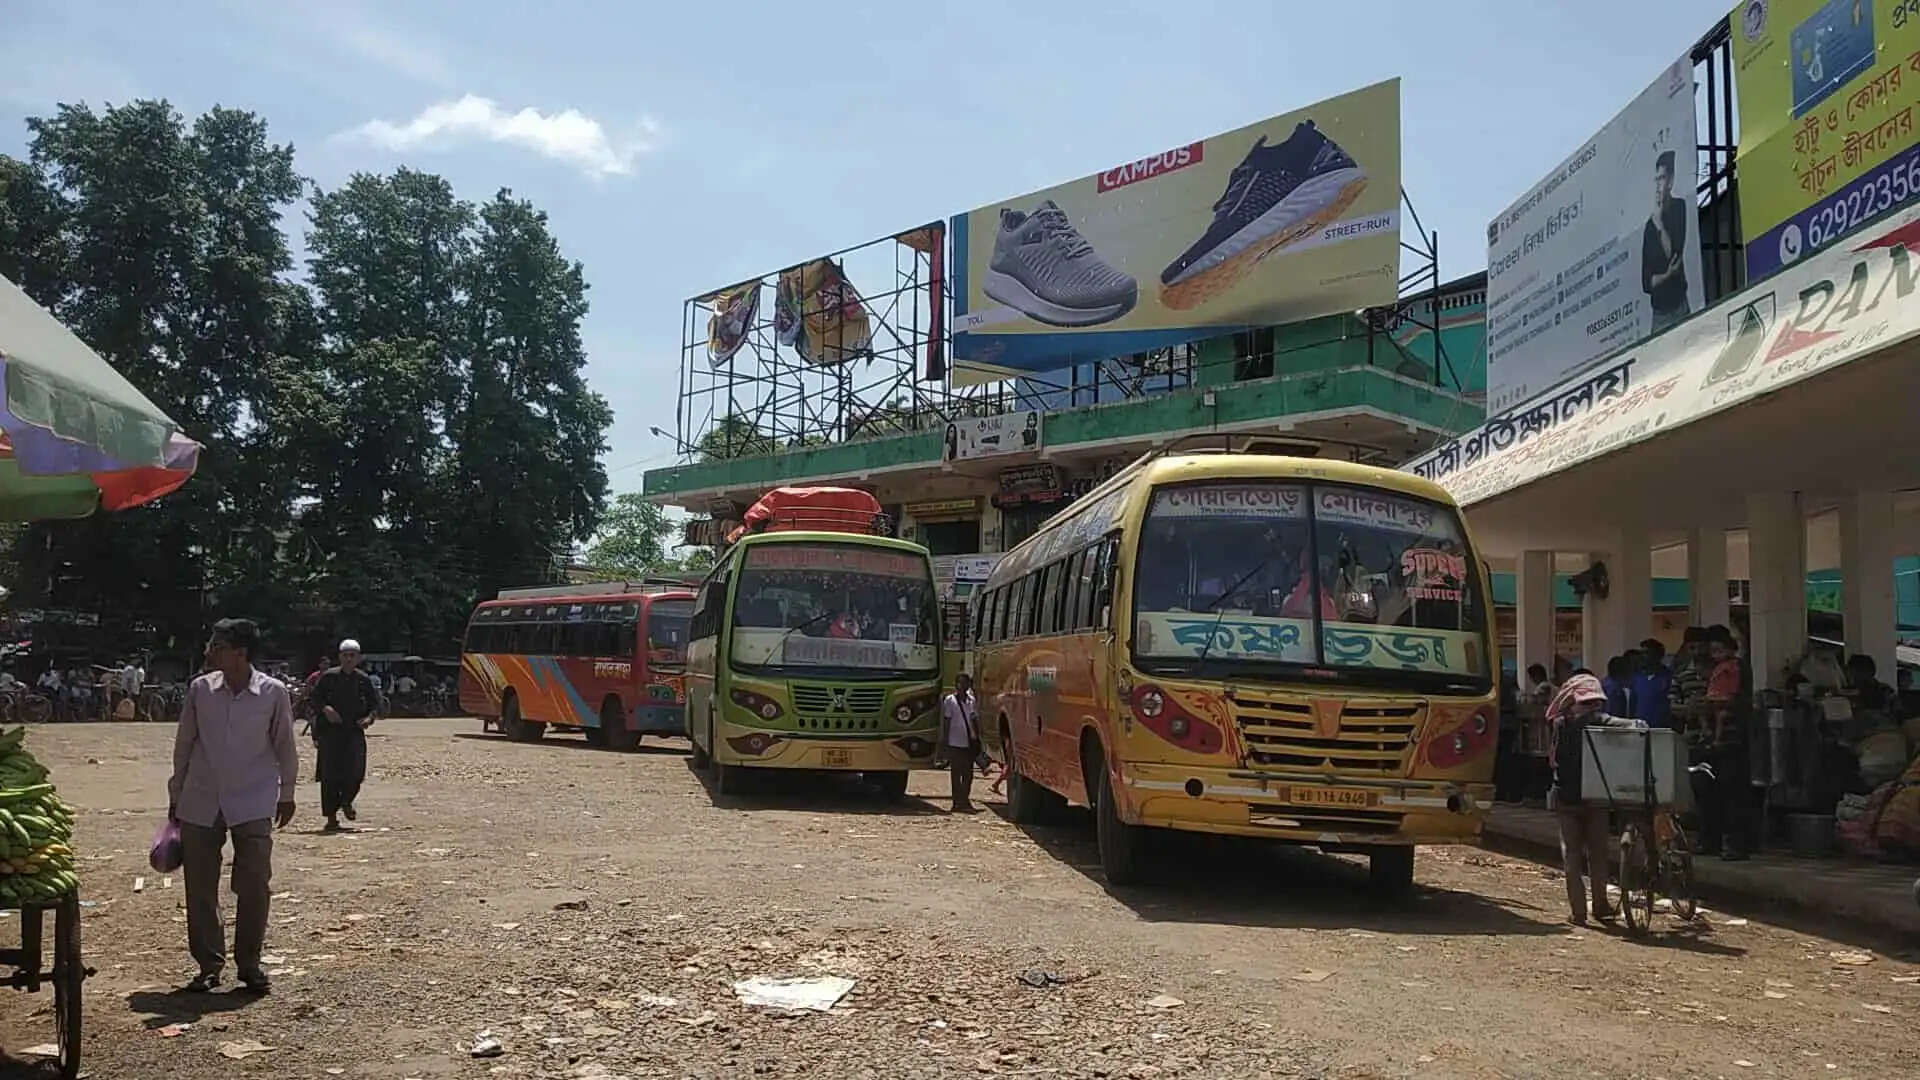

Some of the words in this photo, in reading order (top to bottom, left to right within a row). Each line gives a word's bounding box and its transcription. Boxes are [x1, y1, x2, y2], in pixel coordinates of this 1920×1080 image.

[1824, 109, 1839, 131] ও
[1846, 63, 1901, 122] কোমর
[1841, 106, 1913, 167] জীবনের
[1103, 149, 1192, 187] CAMPUS
[1808, 154, 1920, 248] 62922356
[1324, 215, 1391, 241] STREET-RUN
[1489, 245, 1521, 281] Career
